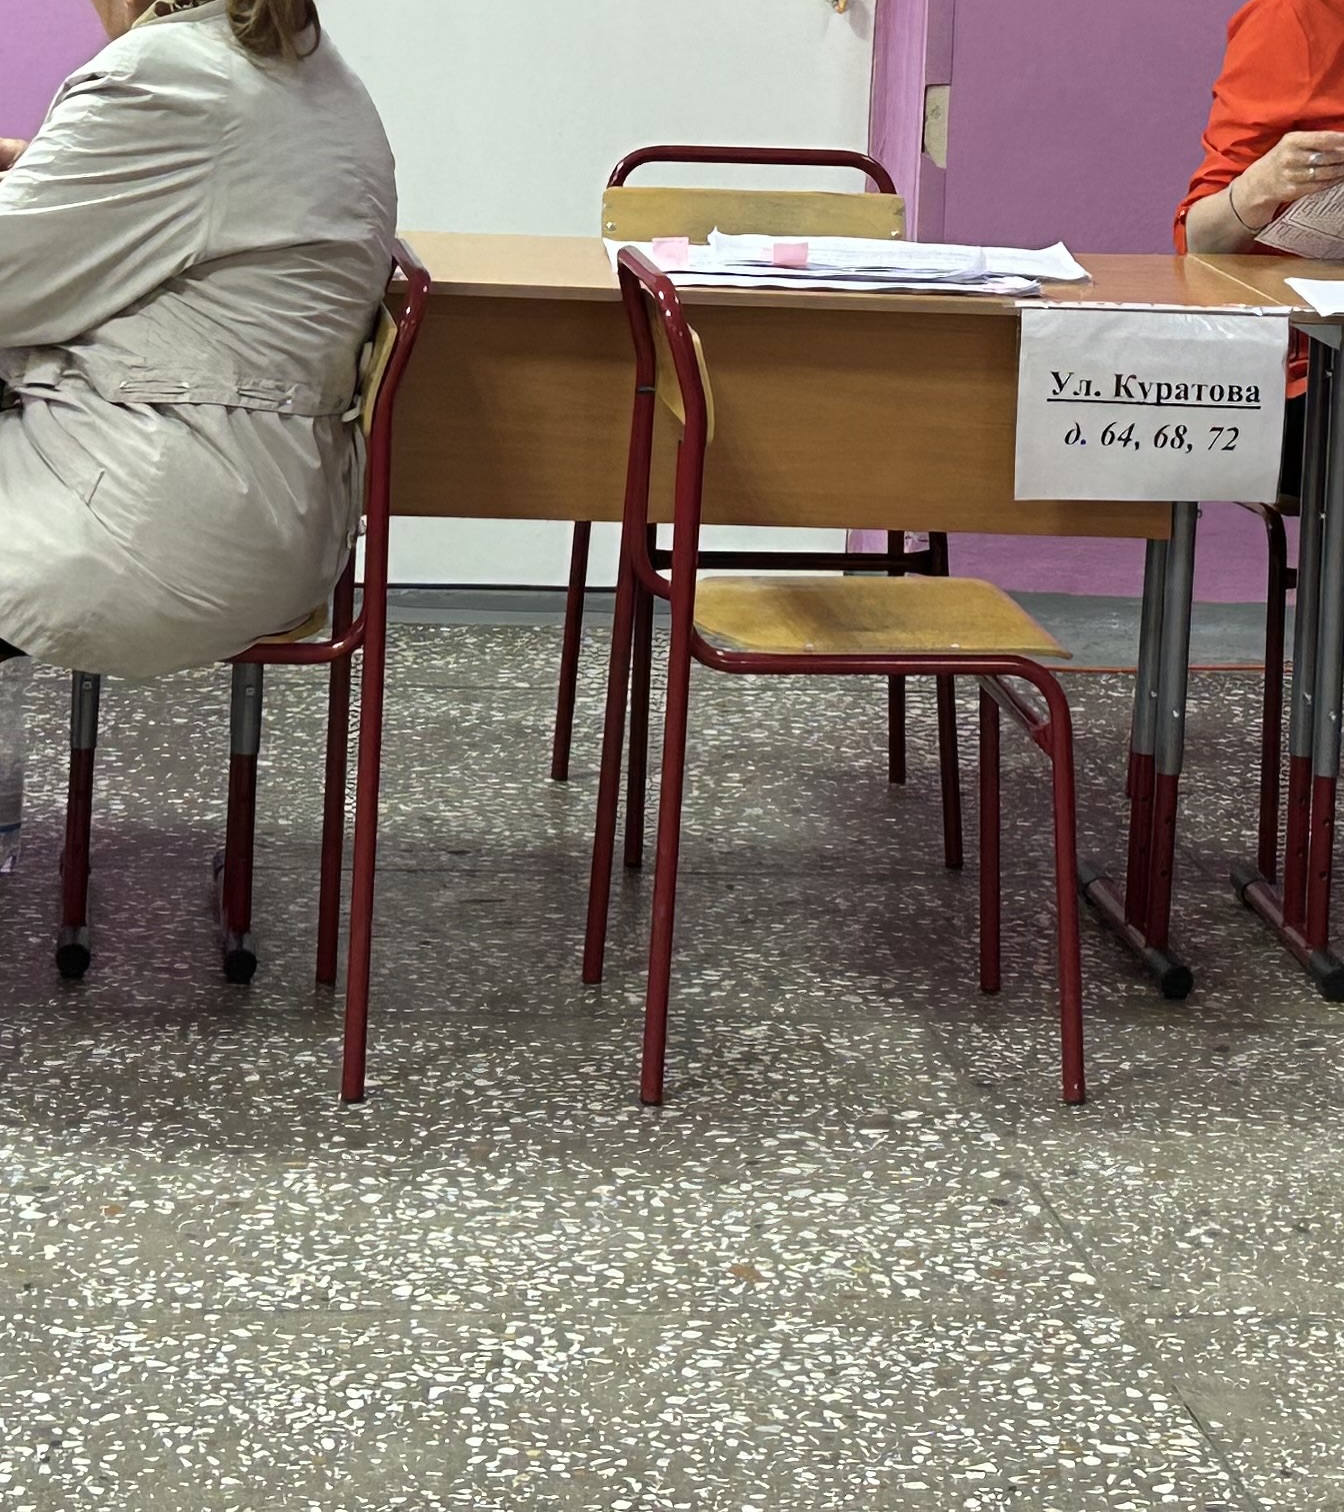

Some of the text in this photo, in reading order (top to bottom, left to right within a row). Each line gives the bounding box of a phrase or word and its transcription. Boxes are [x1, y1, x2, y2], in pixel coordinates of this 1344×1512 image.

[1050, 371, 1261, 406] Ул. Куратова
[1100, 421, 1141, 451] 64,
[1153, 424, 1194, 454] 68,
[1207, 426, 1240, 451] 72
